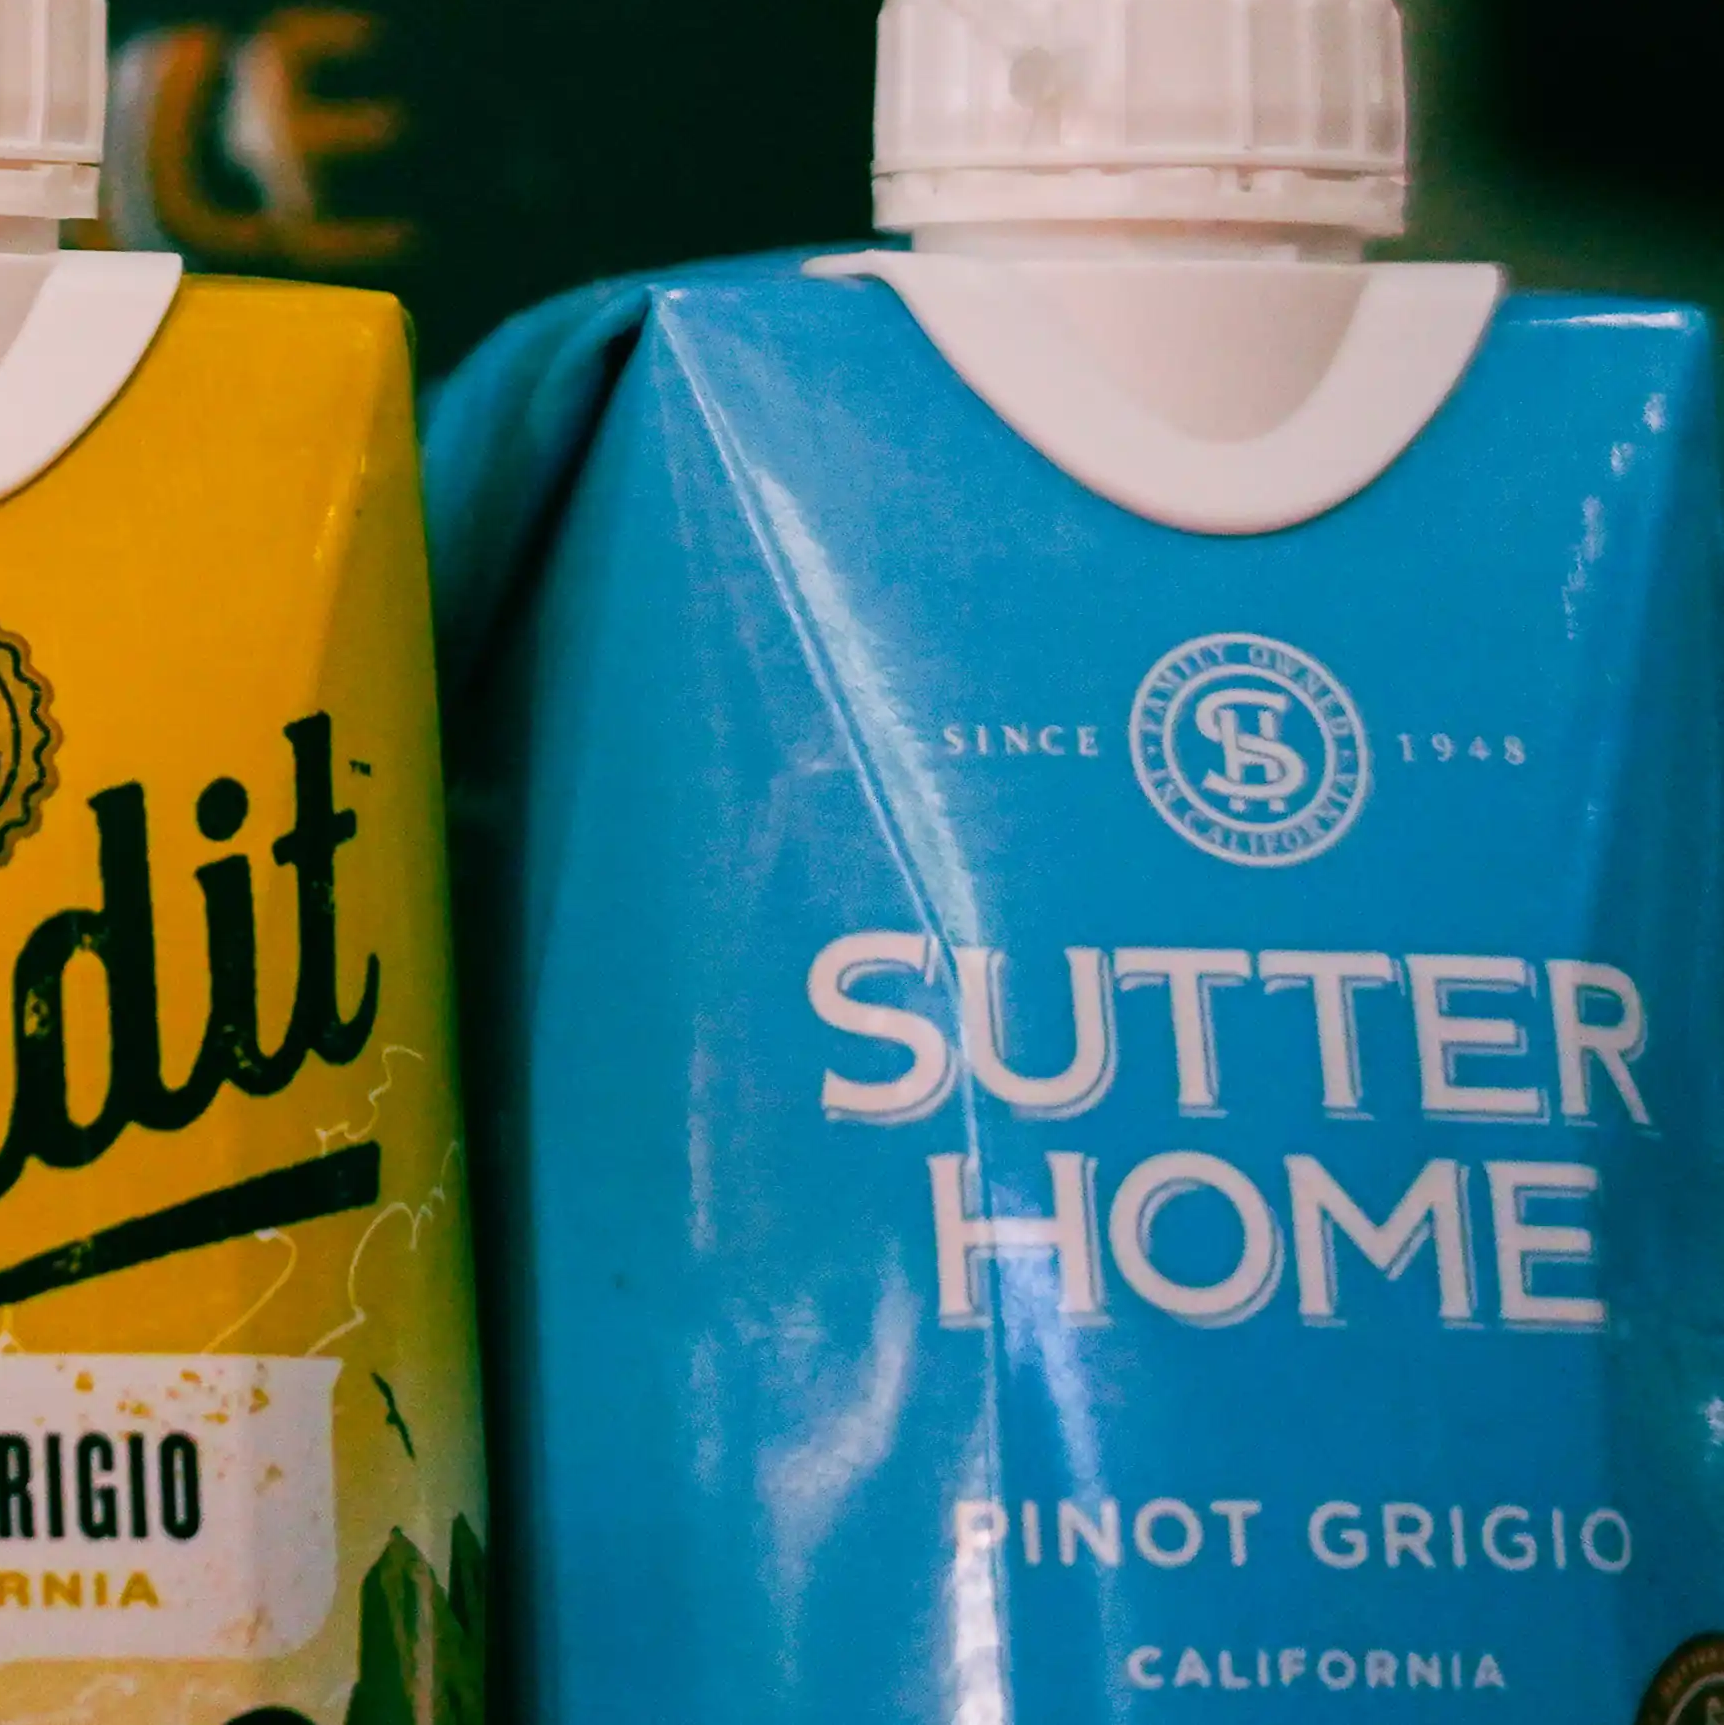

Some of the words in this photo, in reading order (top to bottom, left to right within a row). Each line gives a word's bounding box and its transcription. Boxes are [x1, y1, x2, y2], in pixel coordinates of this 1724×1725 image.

[1139, 644, 1226, 732] FAMILY
[1248, 646, 1351, 736] OWNED
[943, 723, 1099, 757] SINCE
[1396, 732, 1526, 766] 1948
[1183, 773, 1357, 857] CALIFORNIA
[806, 930, 1659, 1136] SUTTER
[927, 1149, 1608, 1332] HOME
[955, 1497, 1261, 1570] PINOT
[1307, 1499, 1633, 1574] GRIGIO
[1126, 1644, 1508, 1692] CALIFORNIA
